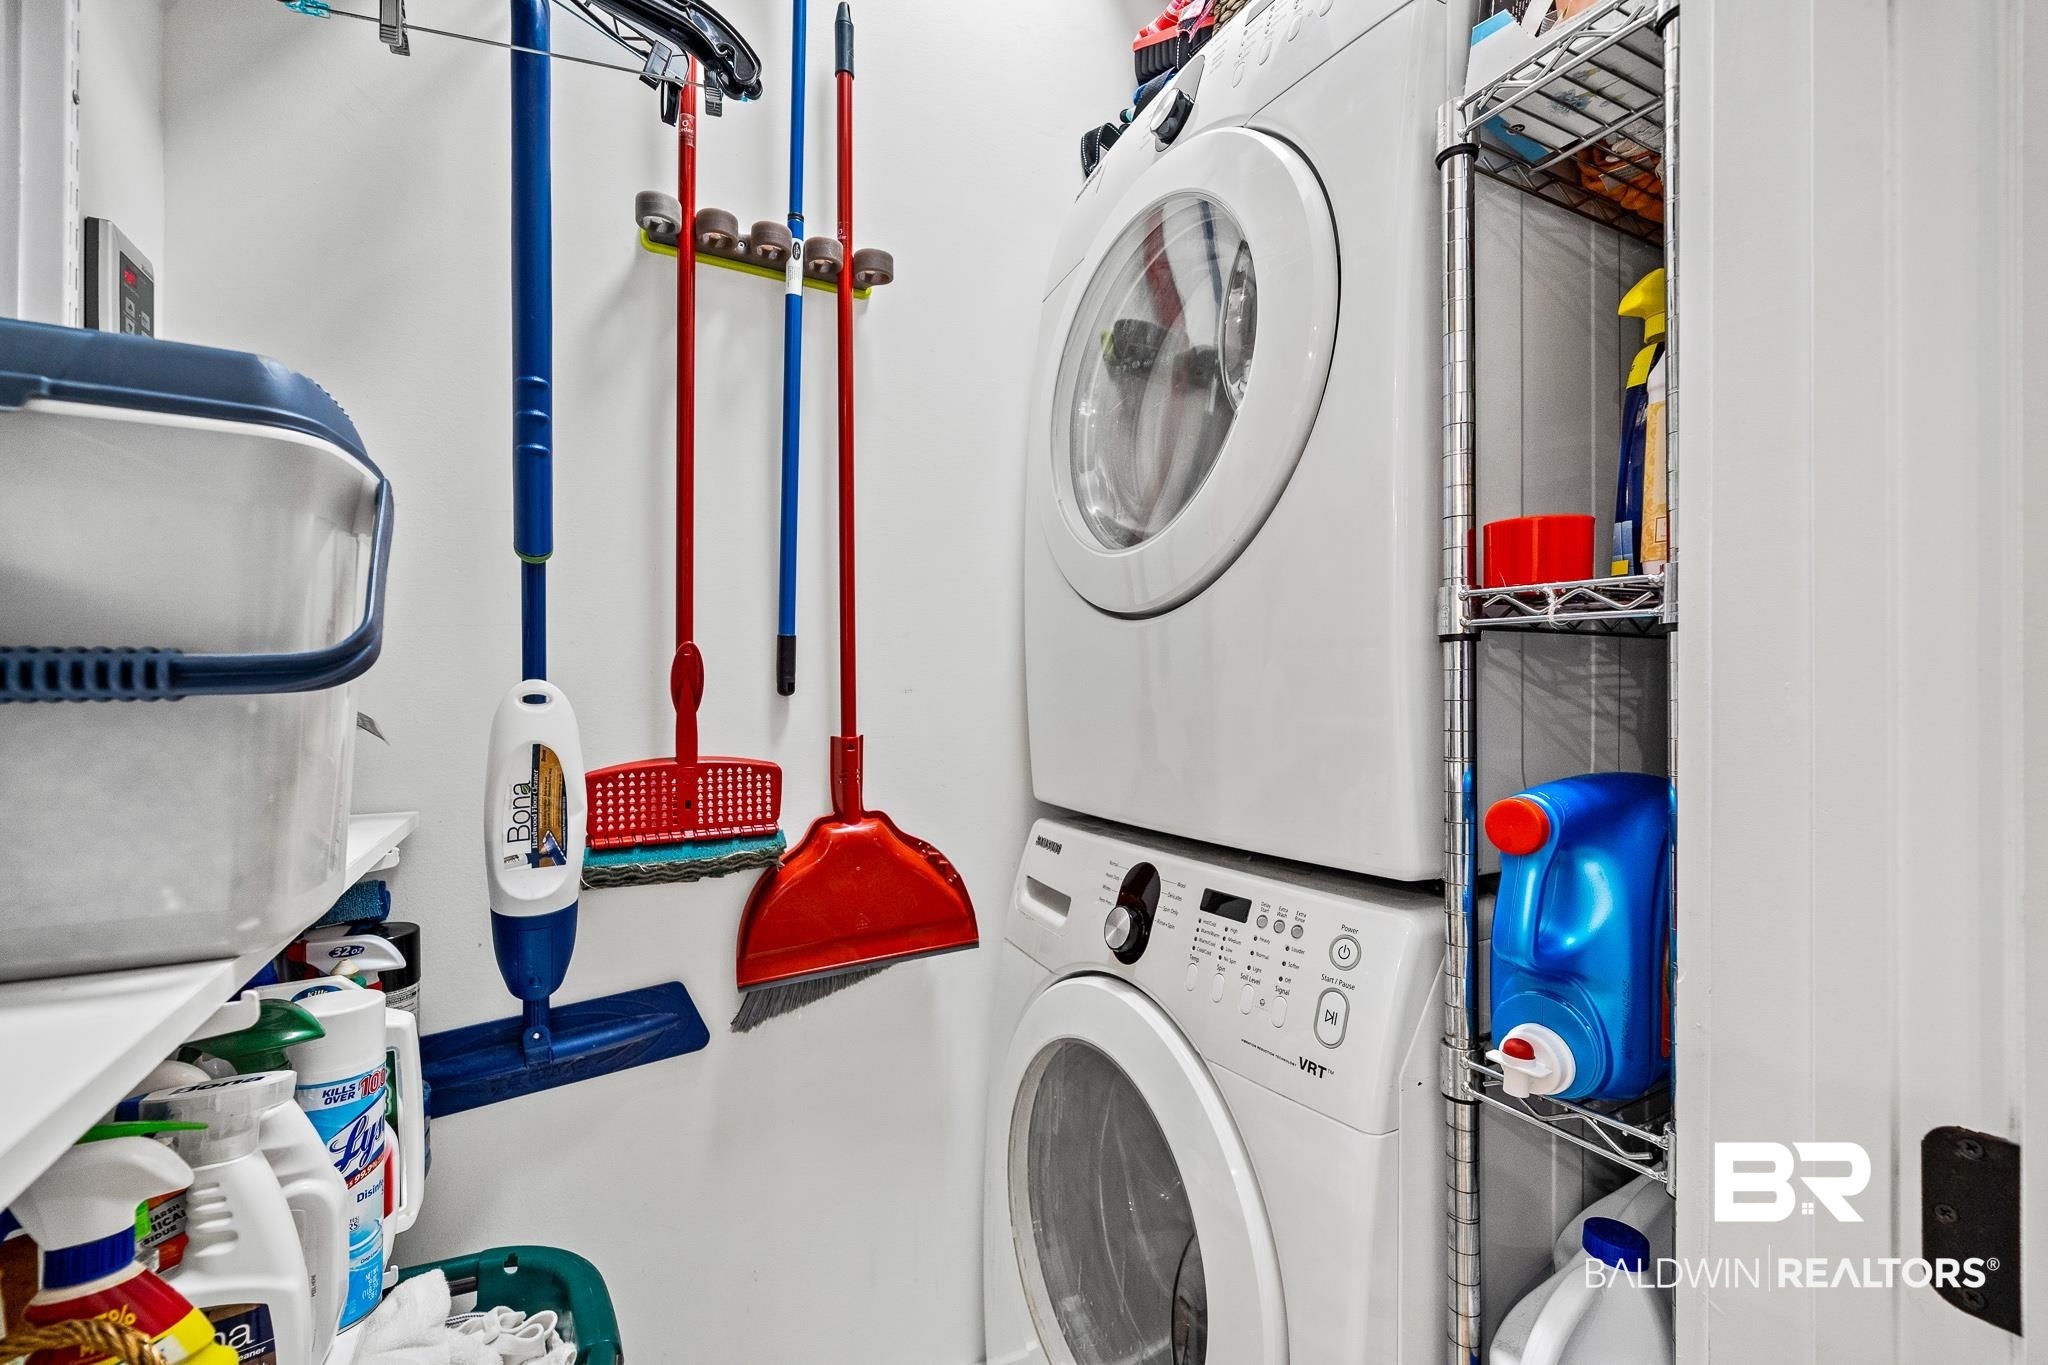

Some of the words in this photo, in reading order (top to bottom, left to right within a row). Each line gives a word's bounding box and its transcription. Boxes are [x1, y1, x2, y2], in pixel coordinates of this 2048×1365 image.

[507, 780, 531, 843] Bona
[1296, 910, 1307, 918] Extra
[1341, 924, 1359, 935] Power
[1228, 936, 1241, 945] Medium
[332, 947, 350, 958] 32
[350, 947, 365, 955] oz
[1255, 951, 1270, 960] Normal
[1290, 947, 1305, 955] Louder
[1216, 964, 1226, 972] Spin
[1252, 966, 1262, 974] Light
[1287, 961, 1300, 970] Softer
[1240, 972, 1249, 981] Soil
[1249, 976, 1261, 985] Level
[1321, 974, 1334, 984] Start
[1338, 979, 1356, 991] Pause
[1275, 985, 1290, 996] Signal
[322, 1083, 356, 1098] KILLS
[323, 1092, 356, 1105] OVER
[329, 1115, 385, 1174] Lys
[142, 1224, 177, 1246] SIDUE
[213, 1324, 256, 1349] na
[238, 1346, 266, 1361] eaner
